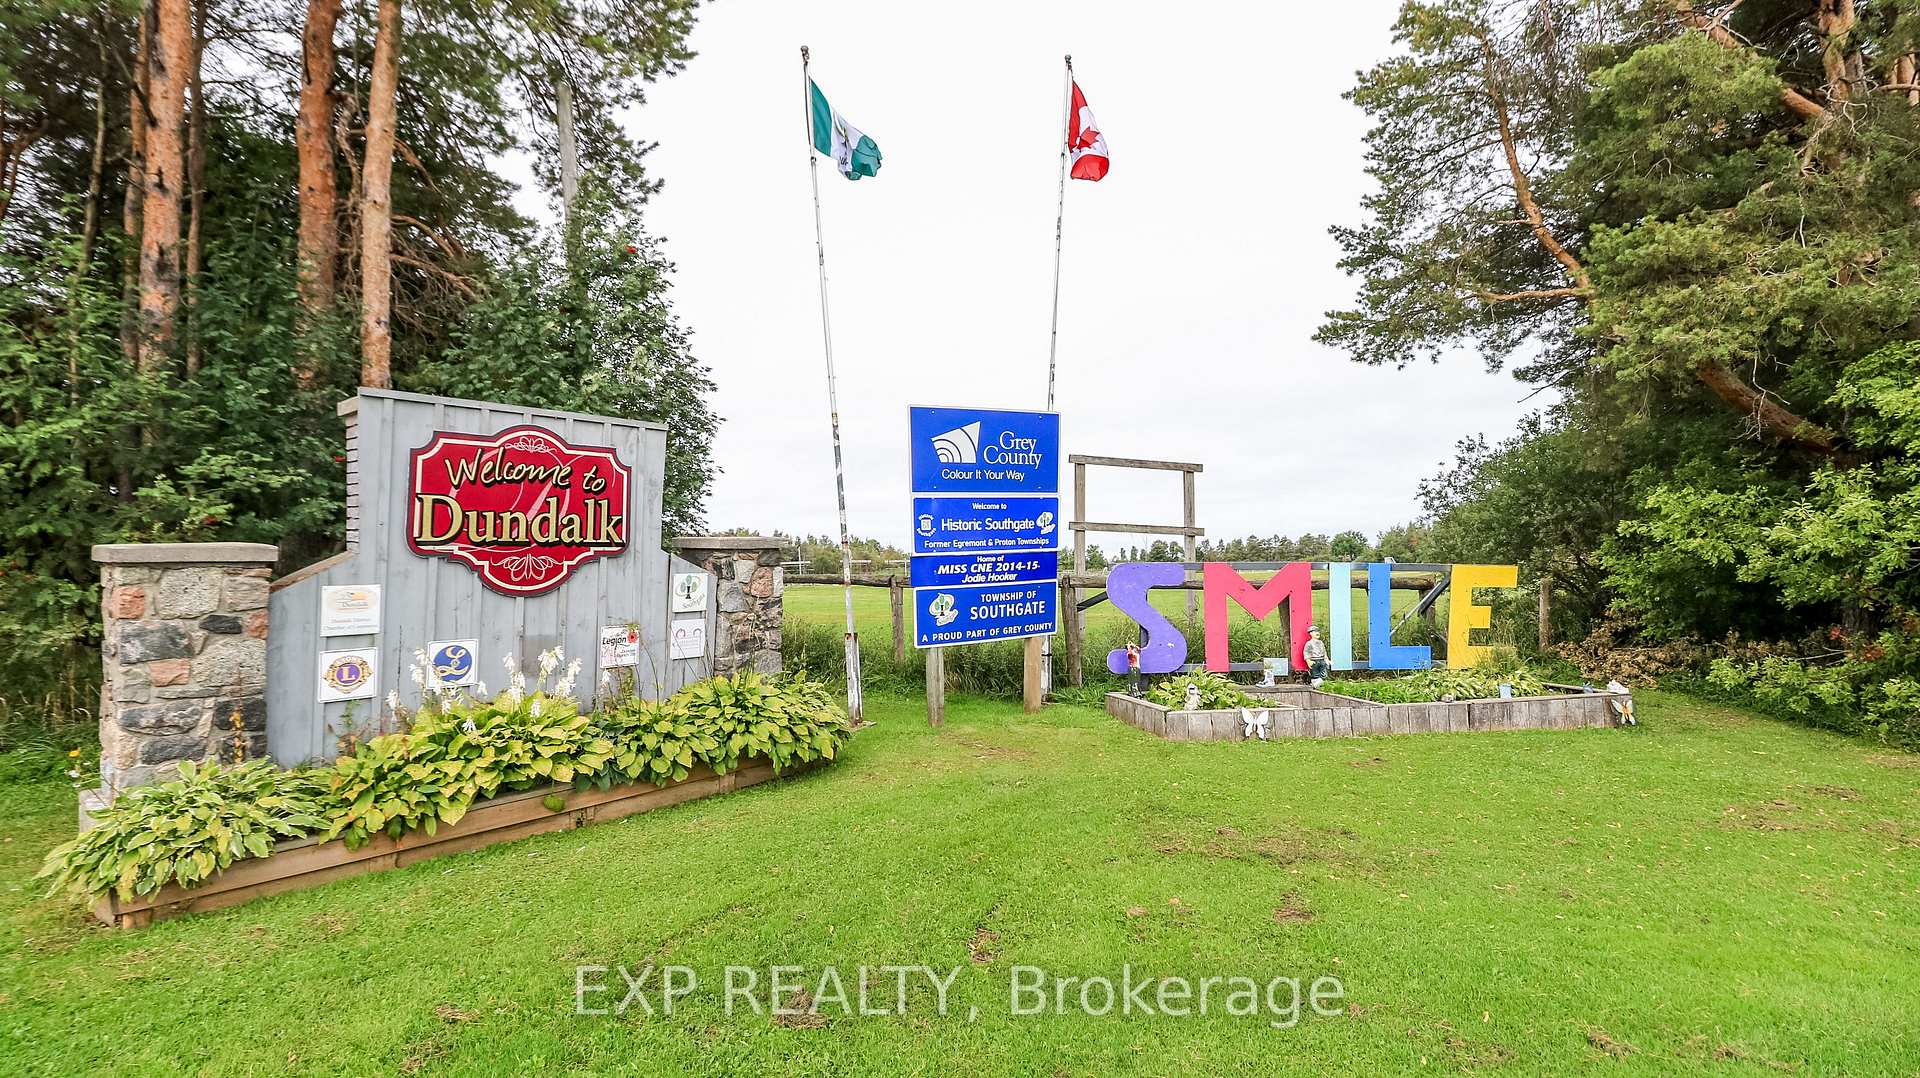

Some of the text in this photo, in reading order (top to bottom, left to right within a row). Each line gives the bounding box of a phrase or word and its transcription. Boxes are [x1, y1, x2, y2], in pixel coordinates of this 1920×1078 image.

[1000, 431, 1037, 454] Grey
[984, 445, 1042, 469] County
[445, 446, 606, 492] Welcome to
[942, 469, 1026, 482] Colour It Your Way
[972, 502, 1000, 510] Welcome
[416, 493, 627, 546] Dundalk
[941, 518, 983, 532] Historic
[985, 517, 1035, 533] Southgate
[924, 536, 1050, 549] Former Egremont & Proton Townships
[977, 555, 997, 563] Home
[938, 564, 967, 575] MISS
[970, 562, 993, 574] CNE
[962, 571, 1018, 584] Jodie Hooker
[981, 590, 1037, 603] TOWNSHIP OF
[970, 601, 1046, 621] SOUTHGATE
[1106, 562, 1518, 675] SMILE
[921, 622, 1053, 643] A PROUD PART OF GREY COUNTY
[602, 637, 627, 647] Legion
[341, 667, 356, 681] L
